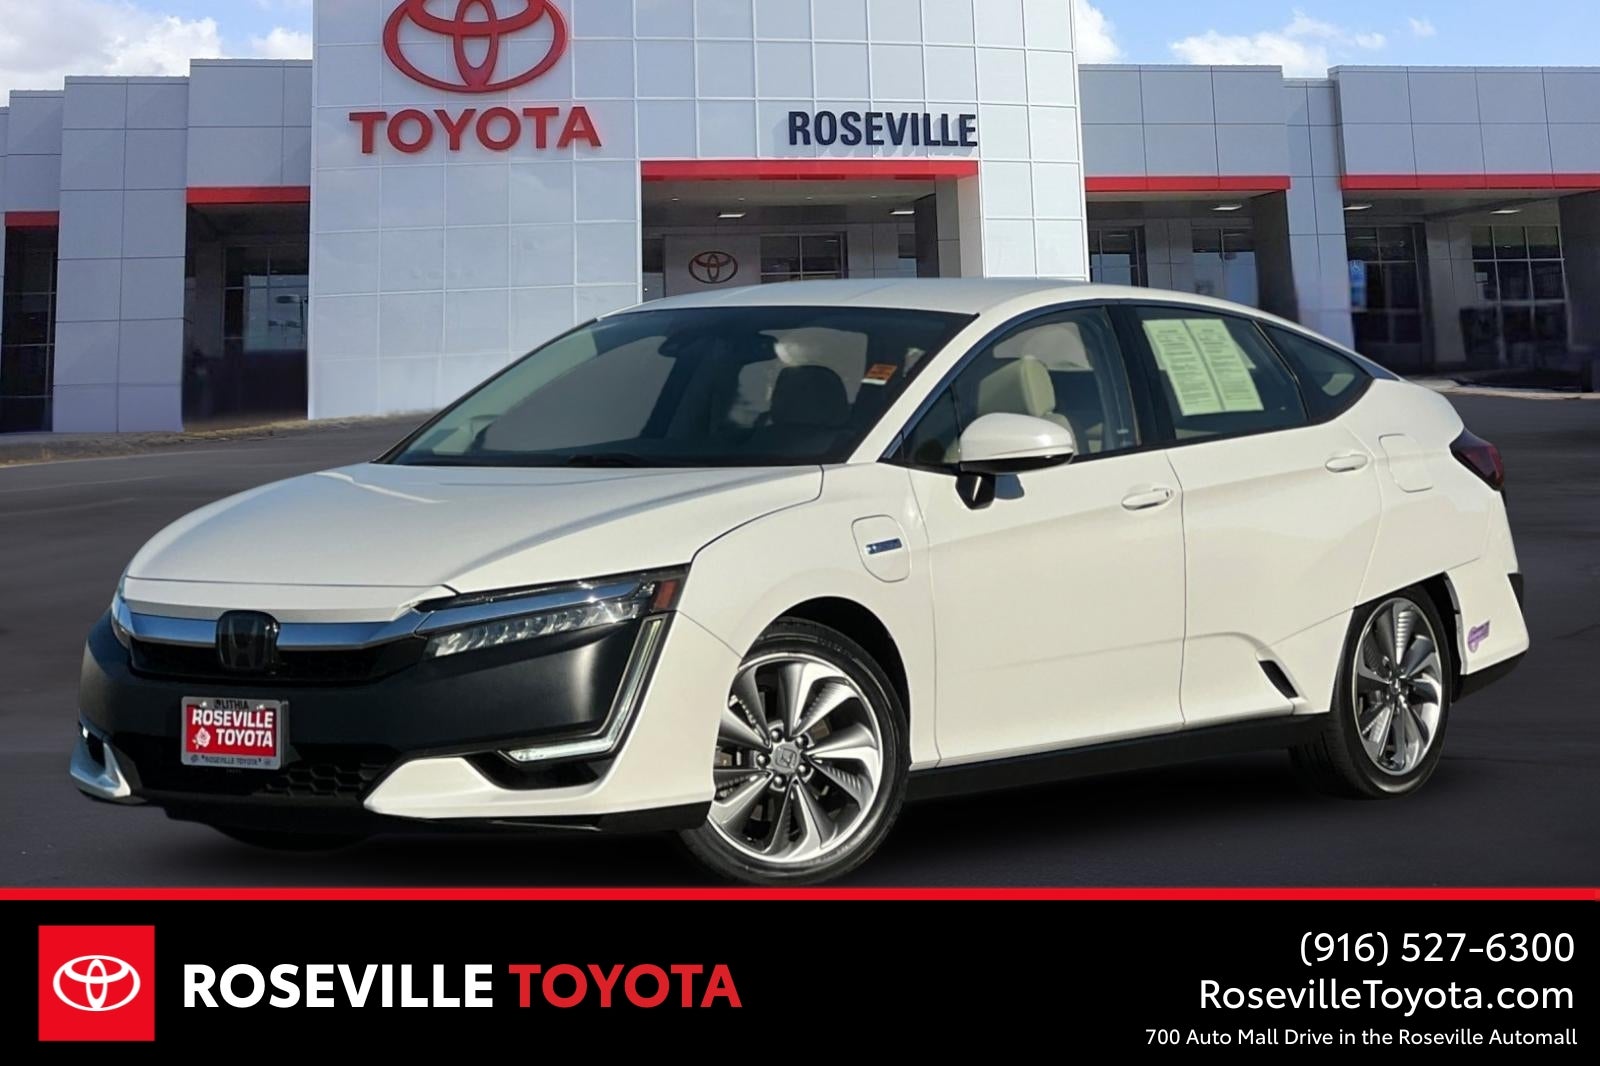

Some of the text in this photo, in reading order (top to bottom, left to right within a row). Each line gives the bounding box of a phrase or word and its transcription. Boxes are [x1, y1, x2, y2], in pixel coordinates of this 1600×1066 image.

[349, 106, 602, 154] TOYOTA
[788, 110, 978, 147] ROSEVILLE
[192, 708, 274, 728] ROSEVILLE
[216, 728, 273, 747] TOYOTA
